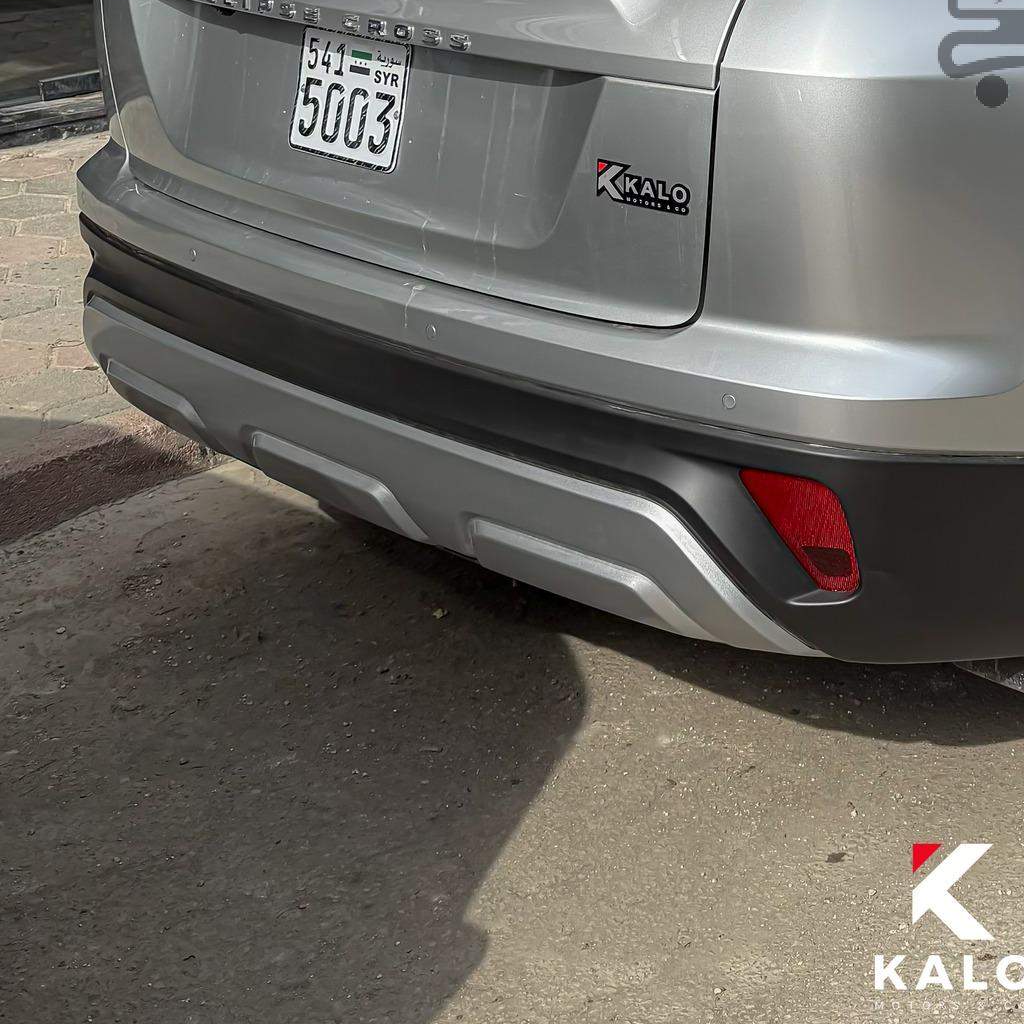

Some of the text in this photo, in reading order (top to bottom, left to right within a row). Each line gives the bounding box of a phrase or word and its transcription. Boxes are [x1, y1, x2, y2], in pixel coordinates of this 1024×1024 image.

[342, 15, 471, 51] CROSS
[307, 38, 346, 76] 541
[374, 70, 399, 88] SYR
[298, 77, 396, 155] 5003
[625, 177, 687, 203] KALO
